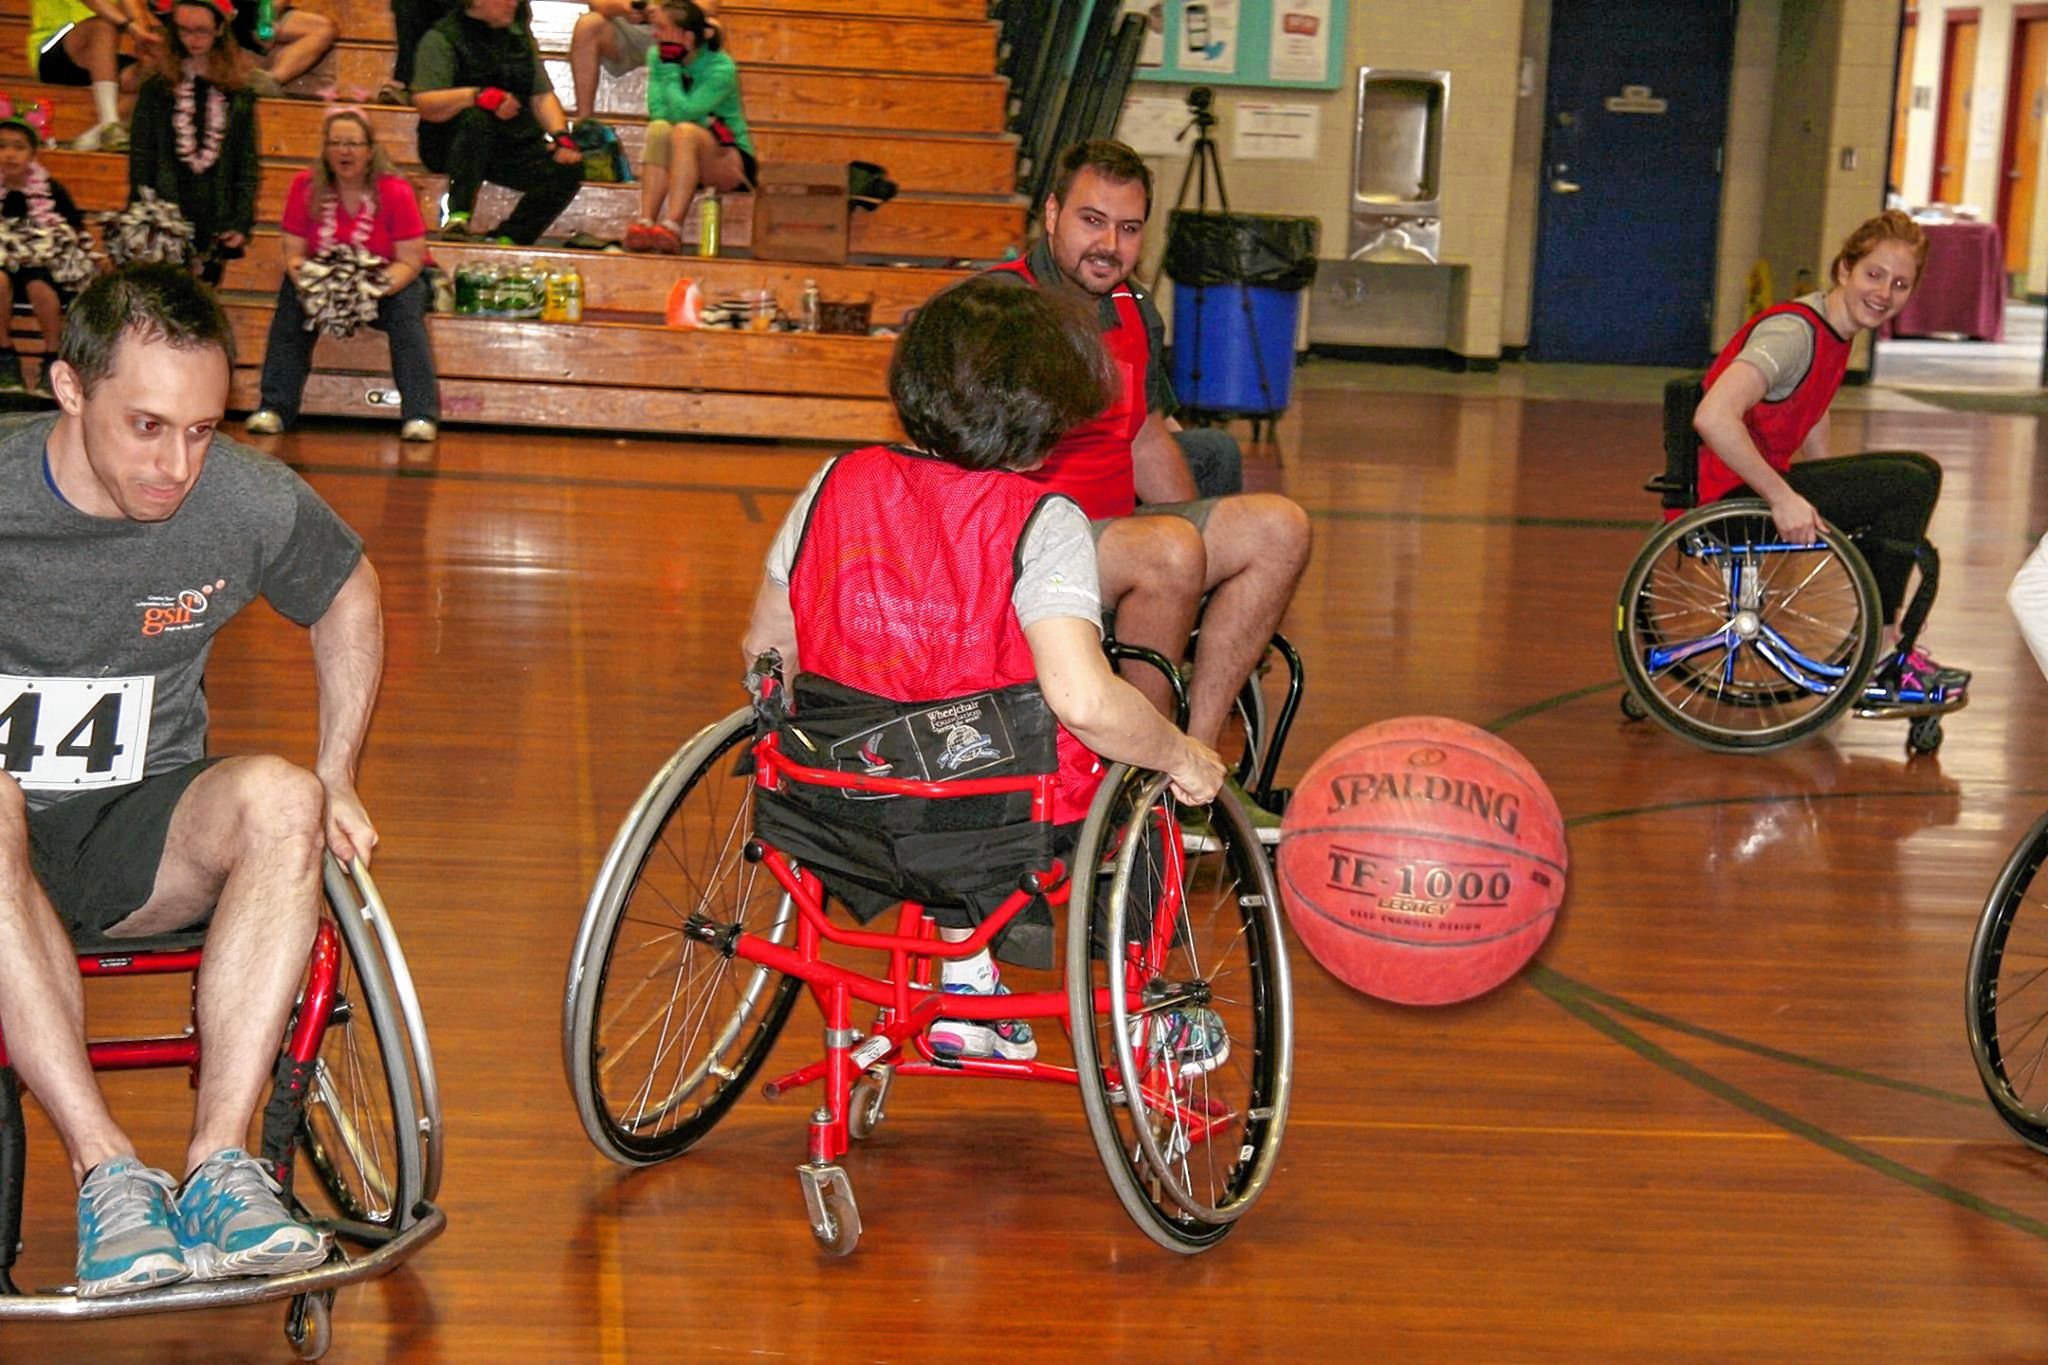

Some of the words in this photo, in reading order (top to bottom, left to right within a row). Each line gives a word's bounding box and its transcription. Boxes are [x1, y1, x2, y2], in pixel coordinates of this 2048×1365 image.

[0, 692, 124, 773] 44
[1328, 773, 1519, 835] SPALDING
[1327, 852, 1511, 901] TF-1000
[1377, 898, 1449, 916] LEGACY
[1438, 922, 1482, 932] DESIGN
